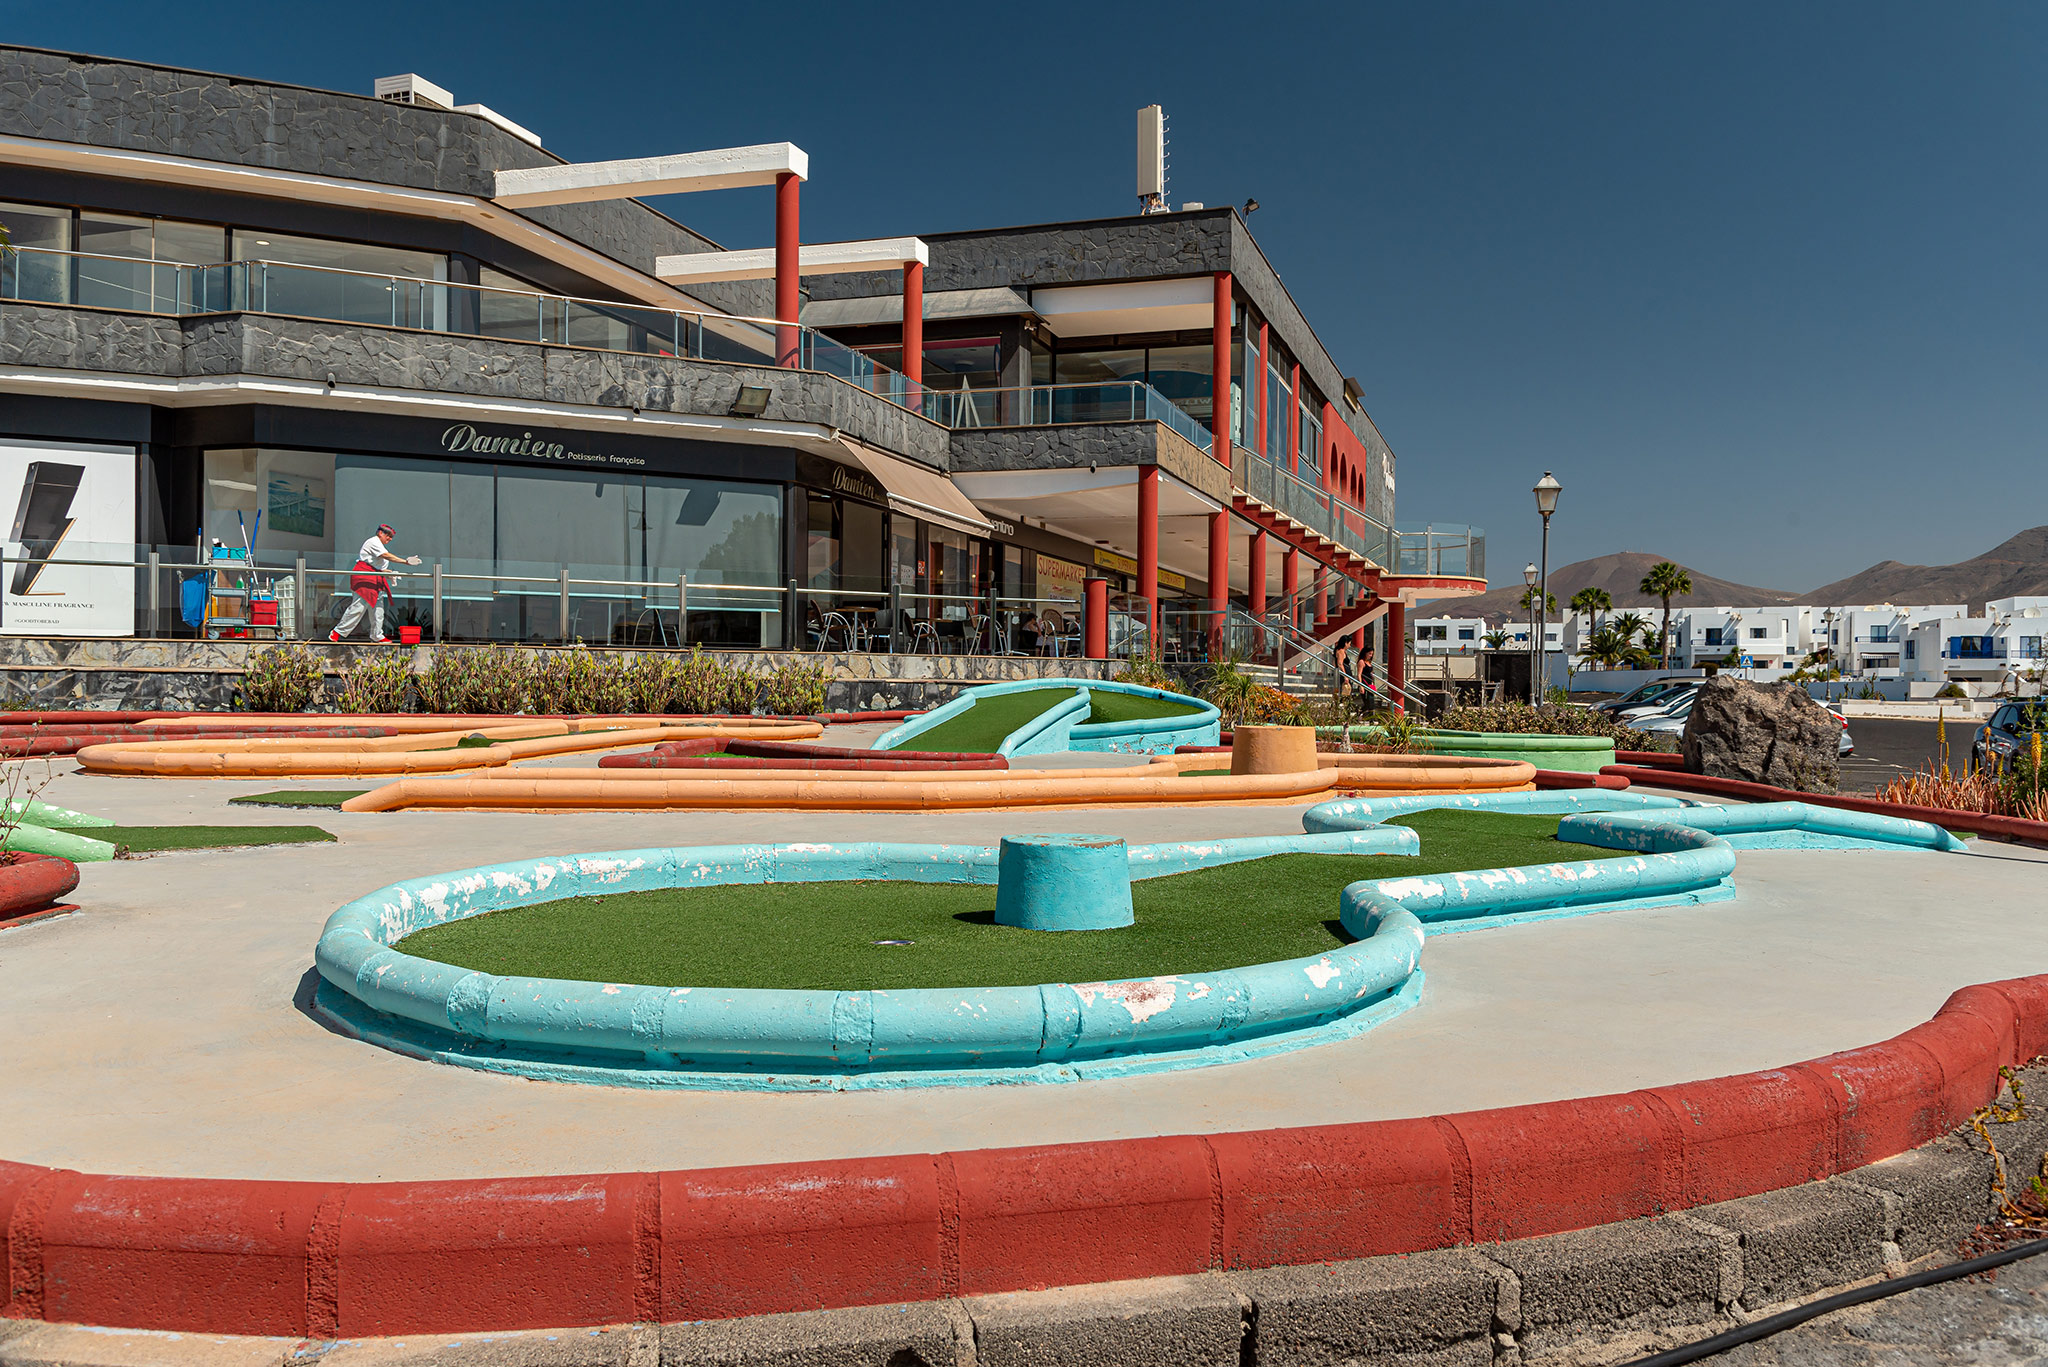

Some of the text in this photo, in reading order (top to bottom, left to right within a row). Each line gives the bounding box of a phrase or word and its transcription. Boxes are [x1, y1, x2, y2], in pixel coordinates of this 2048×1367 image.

[441, 423, 565, 460] Damien
[832, 465, 875, 499] Damien
[1038, 557, 1085, 584] SUPERMARKET
